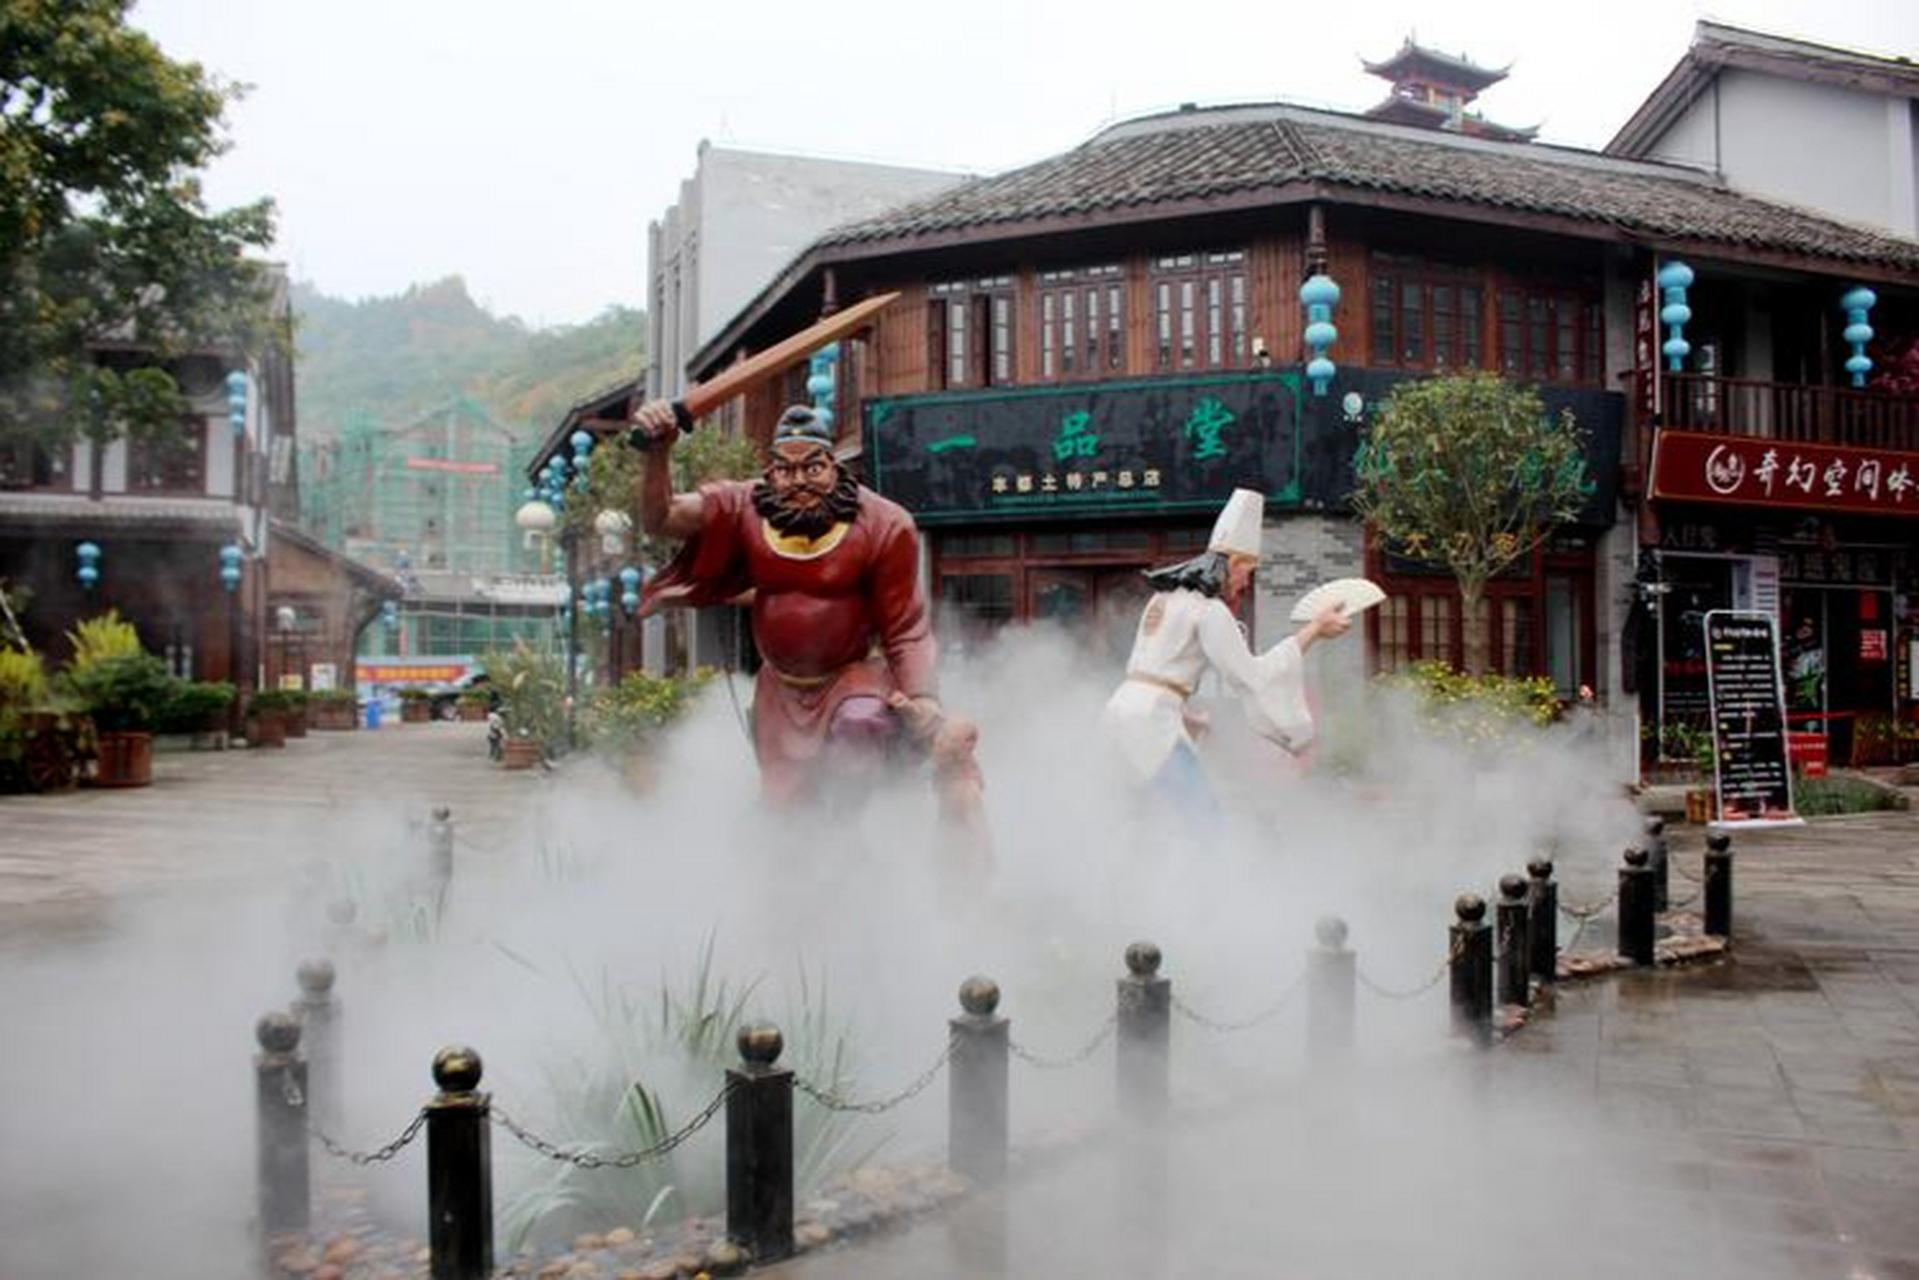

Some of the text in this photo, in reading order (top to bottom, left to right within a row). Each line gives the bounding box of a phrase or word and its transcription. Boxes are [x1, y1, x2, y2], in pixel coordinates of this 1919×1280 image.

[928, 398, 1234, 461] 一品堂
[1753, 448, 1919, 503] 奇幻空间体
